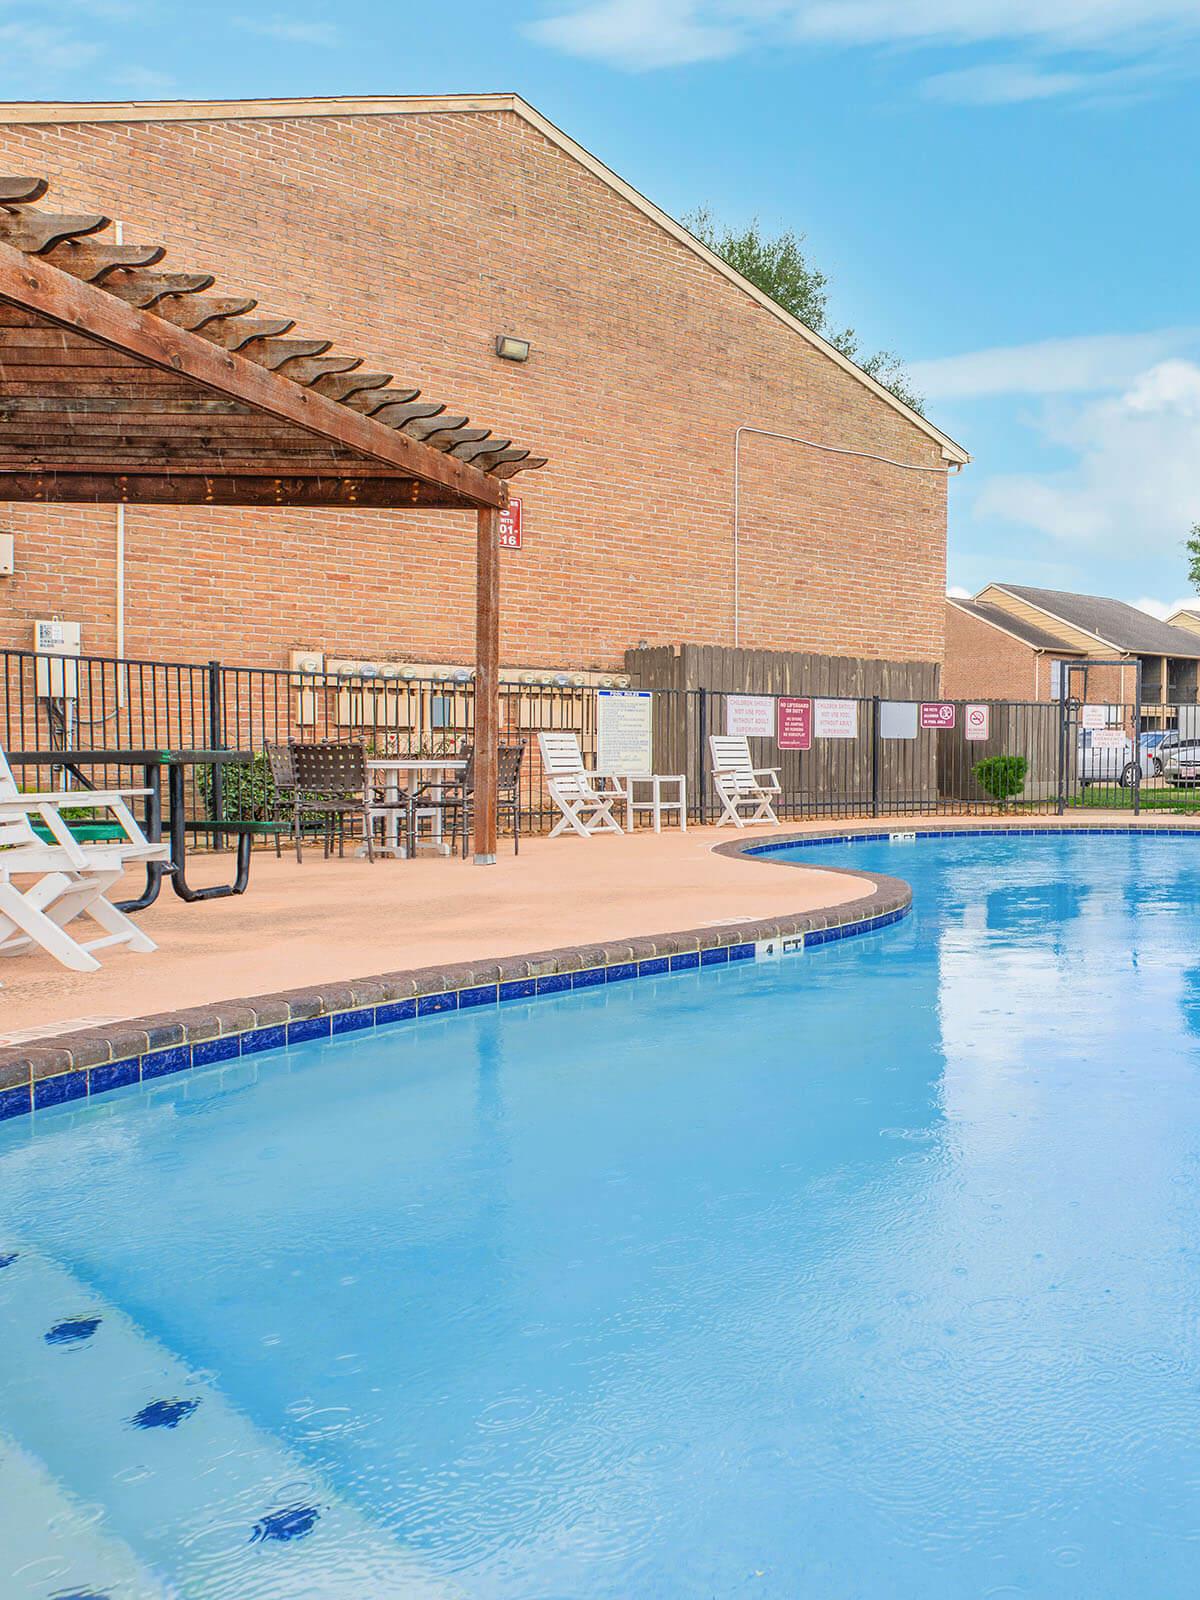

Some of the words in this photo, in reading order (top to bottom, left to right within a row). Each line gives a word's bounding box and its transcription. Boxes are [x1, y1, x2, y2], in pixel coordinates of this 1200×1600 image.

[500, 524, 518, 535] 01-
[499, 535, 517, 545] 16
[783, 938, 801, 951] FT
